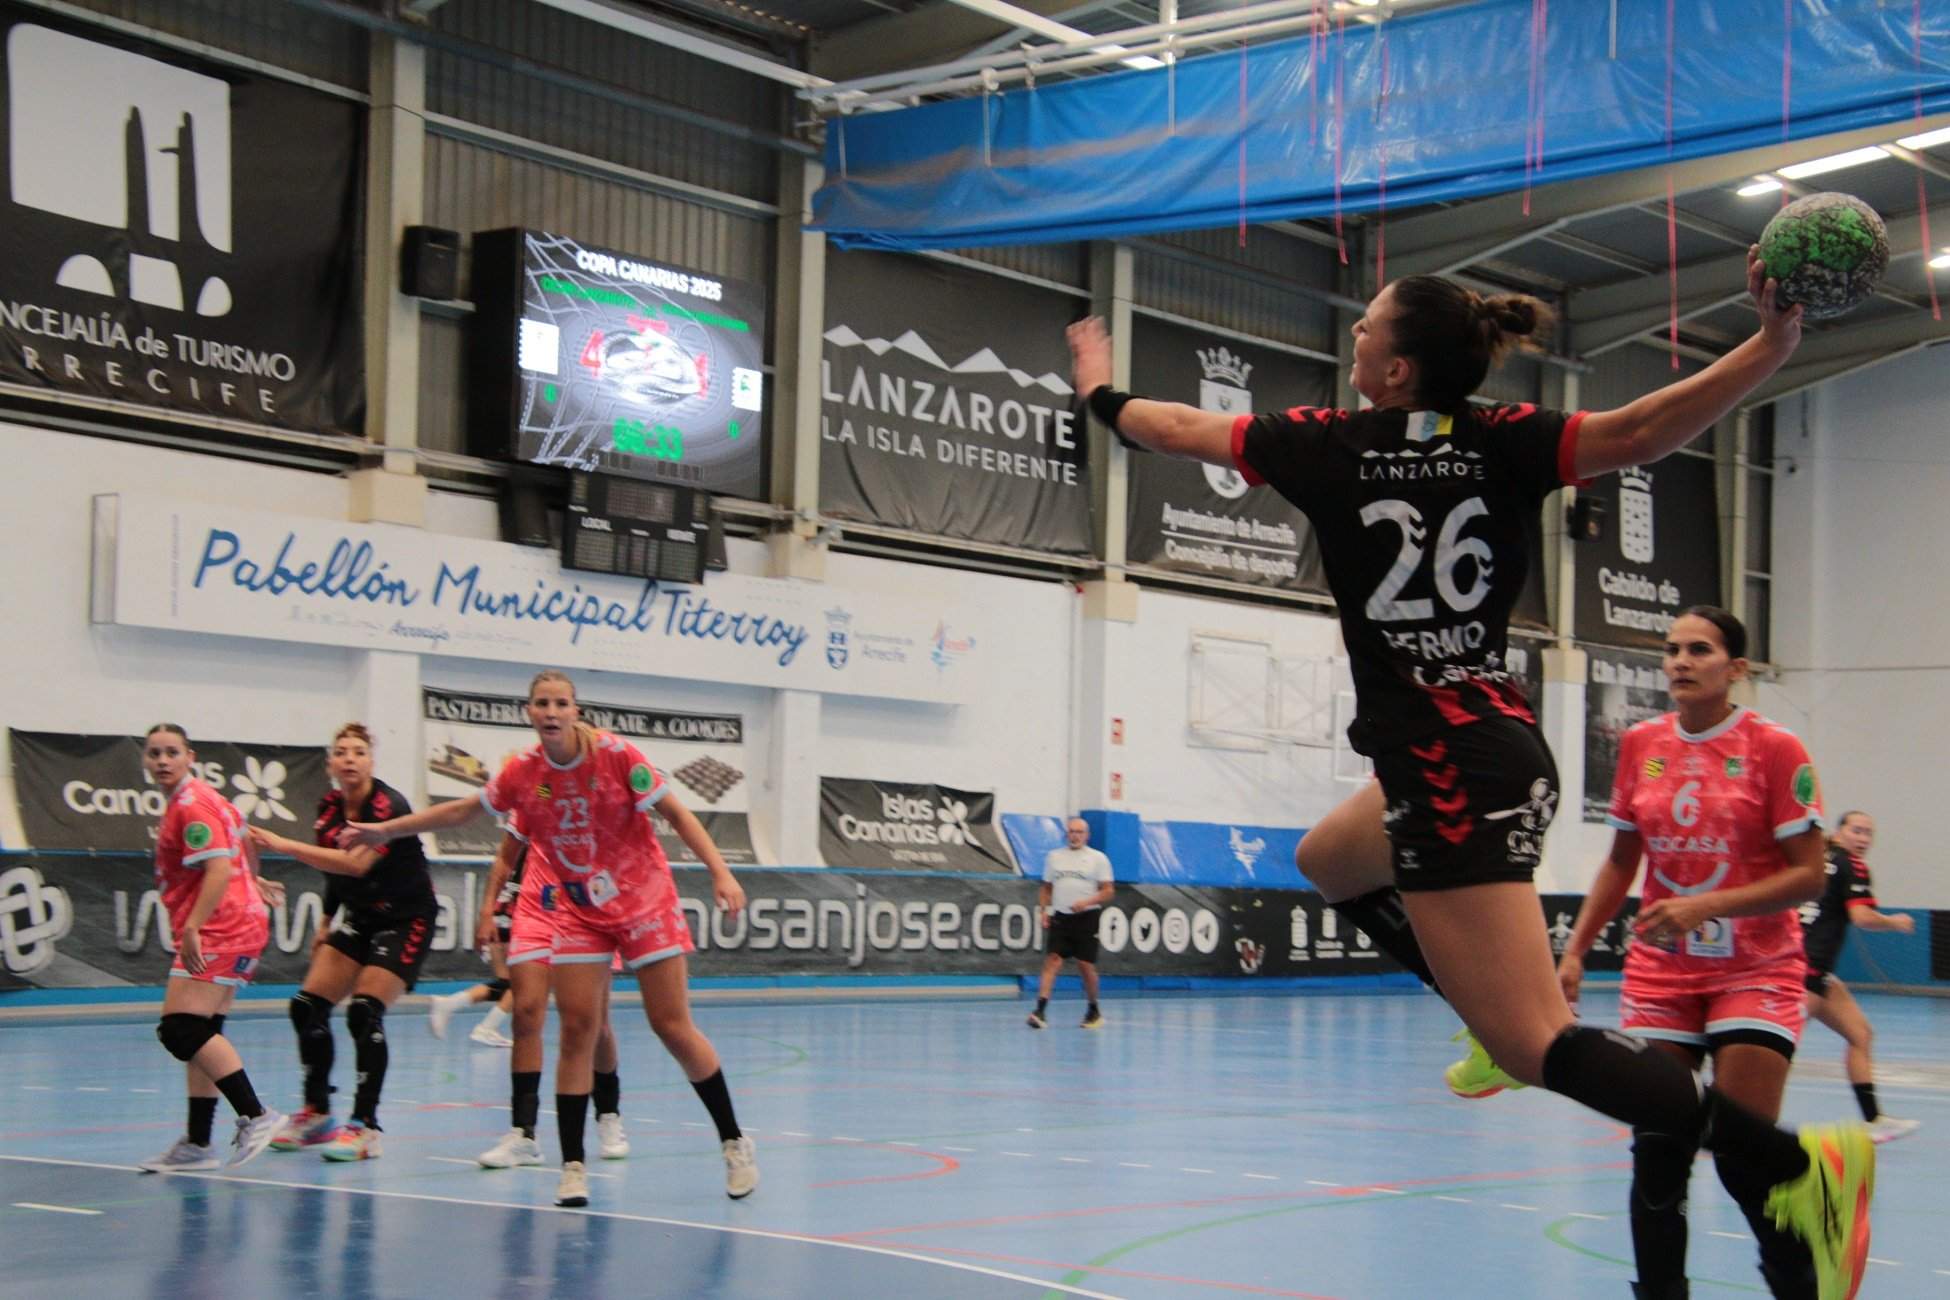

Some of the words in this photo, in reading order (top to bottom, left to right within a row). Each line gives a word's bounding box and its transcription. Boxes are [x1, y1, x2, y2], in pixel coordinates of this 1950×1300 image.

[577, 250, 617, 276] COPA
[618, 260, 688, 294] CANARIAS
[135, 327, 169, 358] de
[173, 334, 296, 381] TURISMO
[821, 359, 1077, 449] LANZAROTE
[822, 415, 858, 445] LA
[867, 425, 926, 459] ISLA
[937, 439, 1078, 486] DIFERENTE
[1360, 461, 1486, 480] LANZAROE
[1359, 497, 1495, 622] 26
[192, 529, 419, 607] Pabellón
[432, 562, 660, 645] Municipal
[661, 588, 808, 668] Titerroy
[1598, 567, 1657, 602] Cabildo
[1659, 579, 1680, 605] de
[668, 717, 740, 739] COOKIES
[62, 780, 167, 816] Cana
[555, 797, 589, 830] 23
[881, 791, 935, 821] Islas
[1671, 780, 1701, 827] 6
[839, 813, 940, 845] Canarias
